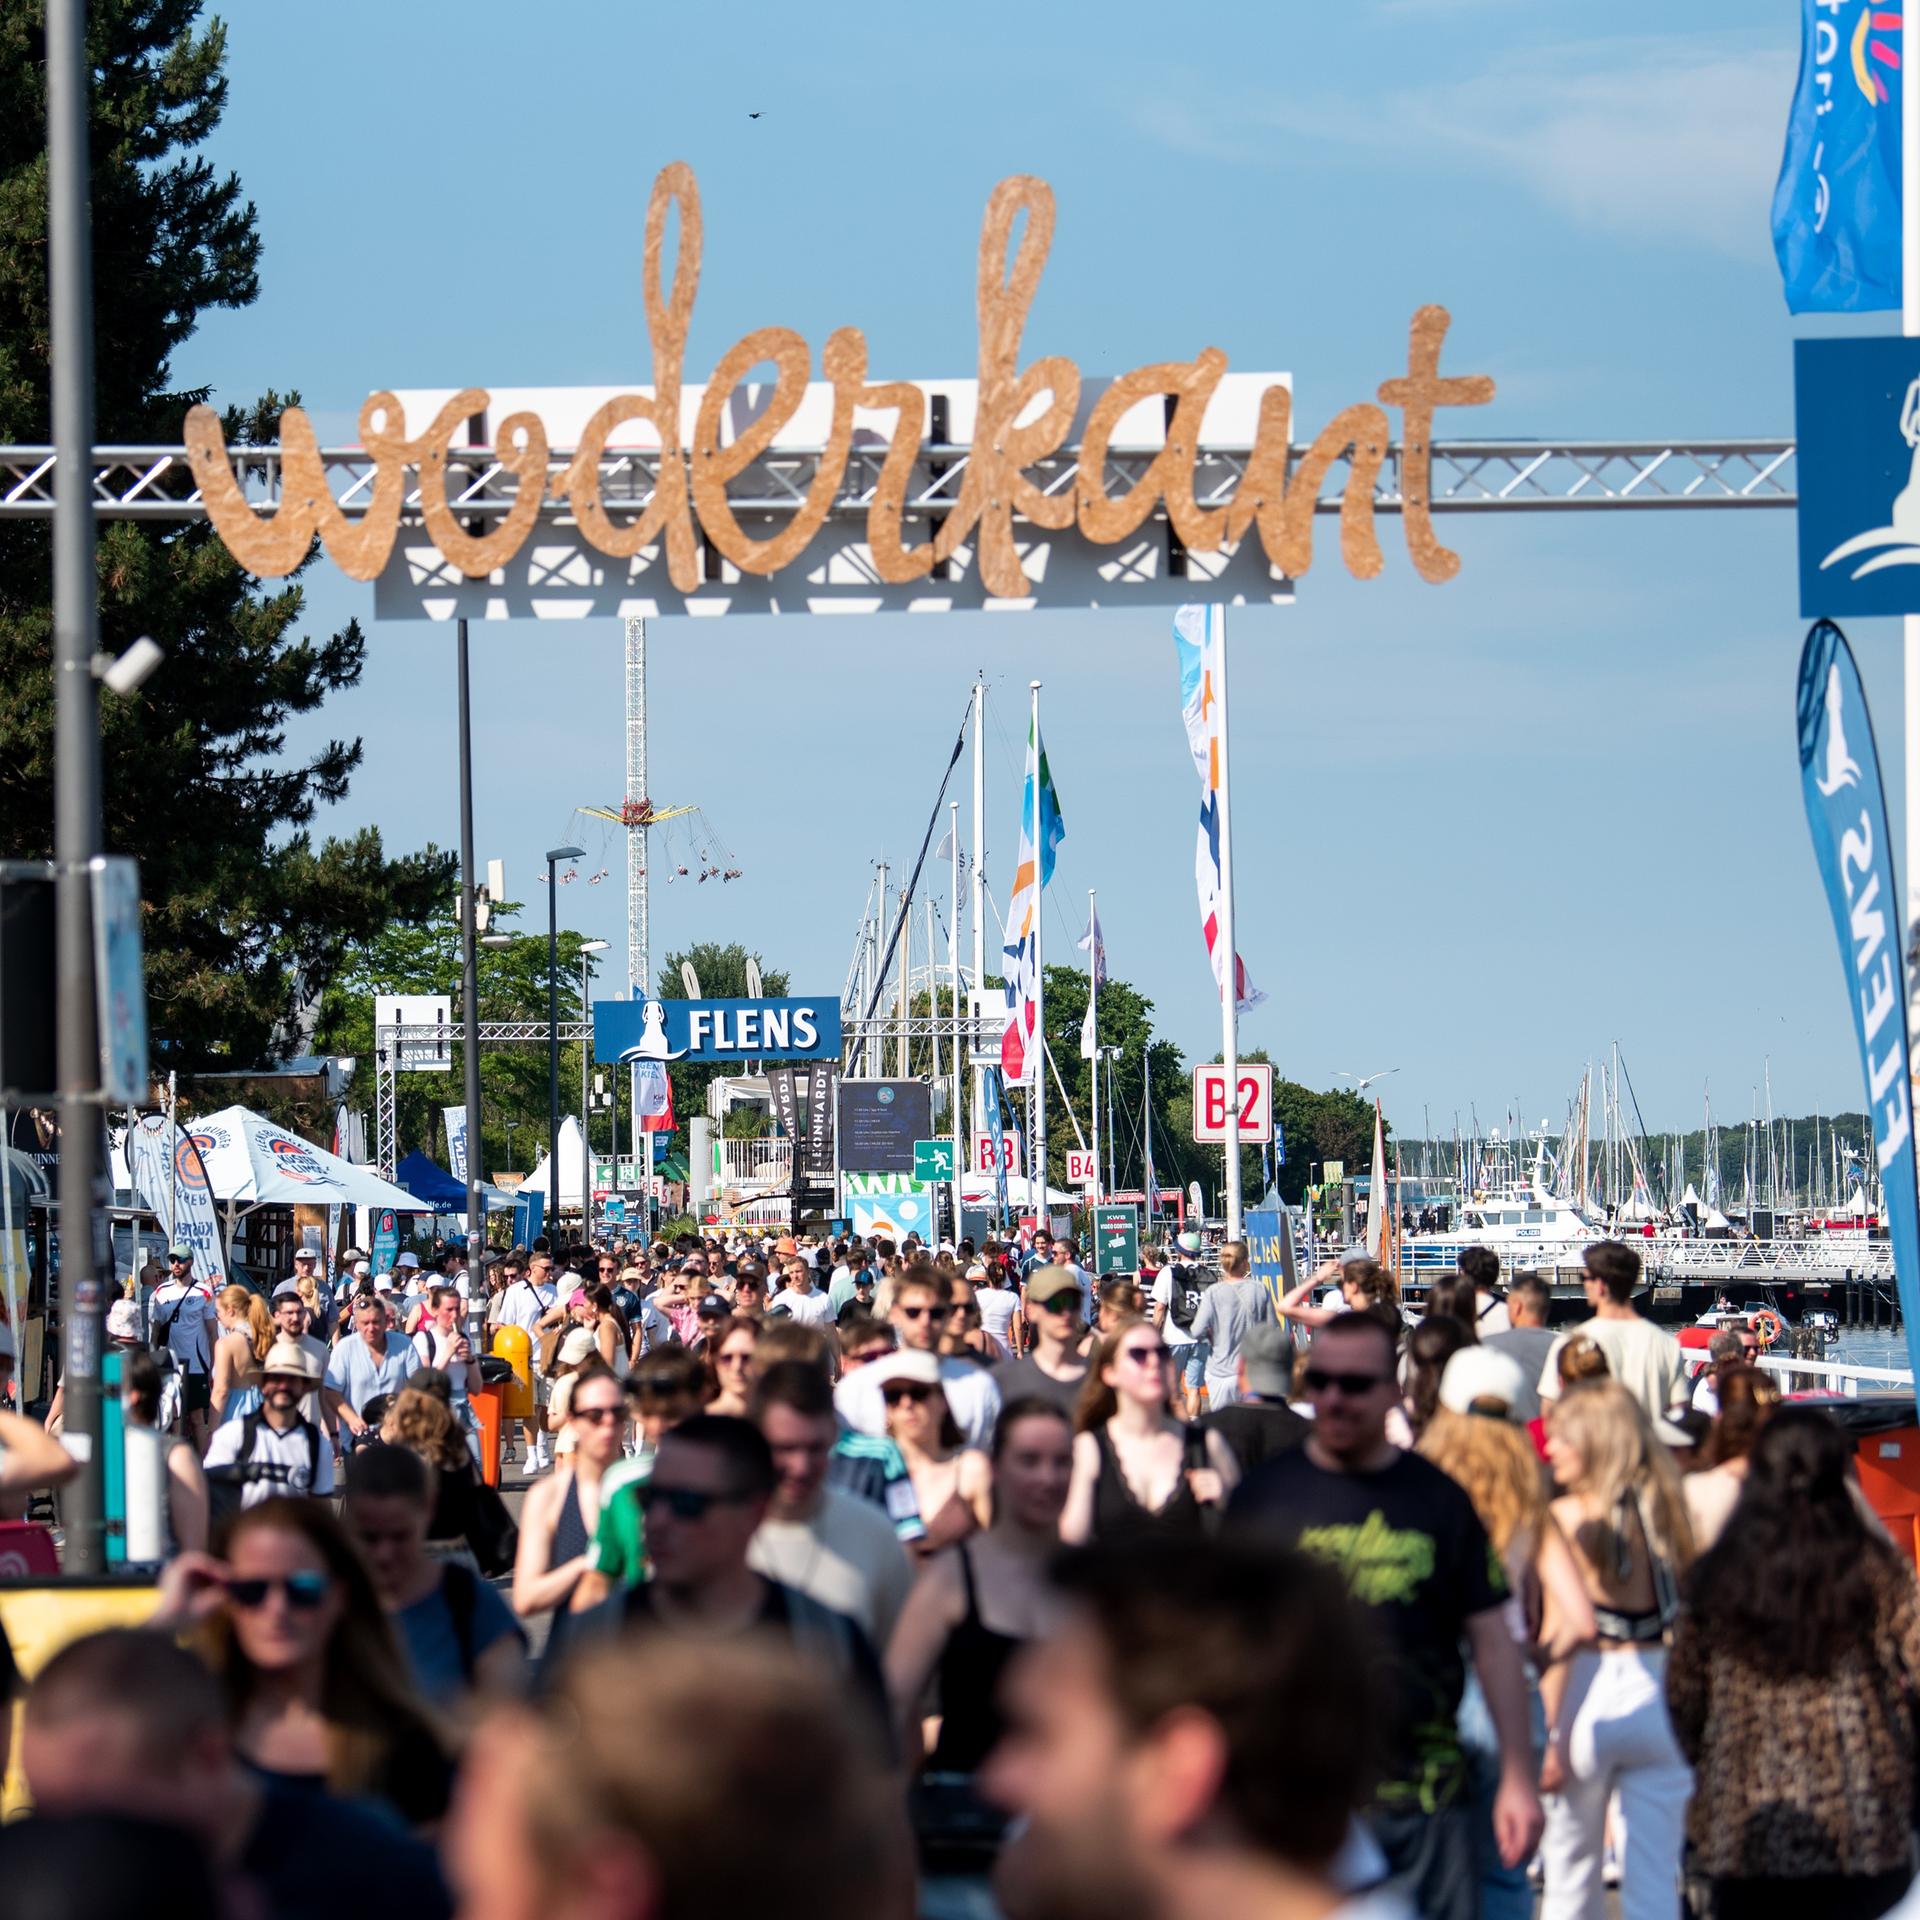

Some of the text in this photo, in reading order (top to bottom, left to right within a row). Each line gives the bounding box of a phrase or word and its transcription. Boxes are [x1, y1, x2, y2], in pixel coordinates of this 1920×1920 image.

[183, 161, 1495, 598] woderkant
[689, 1008, 819, 1050] FLENS
[811, 1069, 827, 1167] LEONHARDT
[1206, 1077, 1259, 1129] B2
[1071, 1156, 1094, 1178] B4
